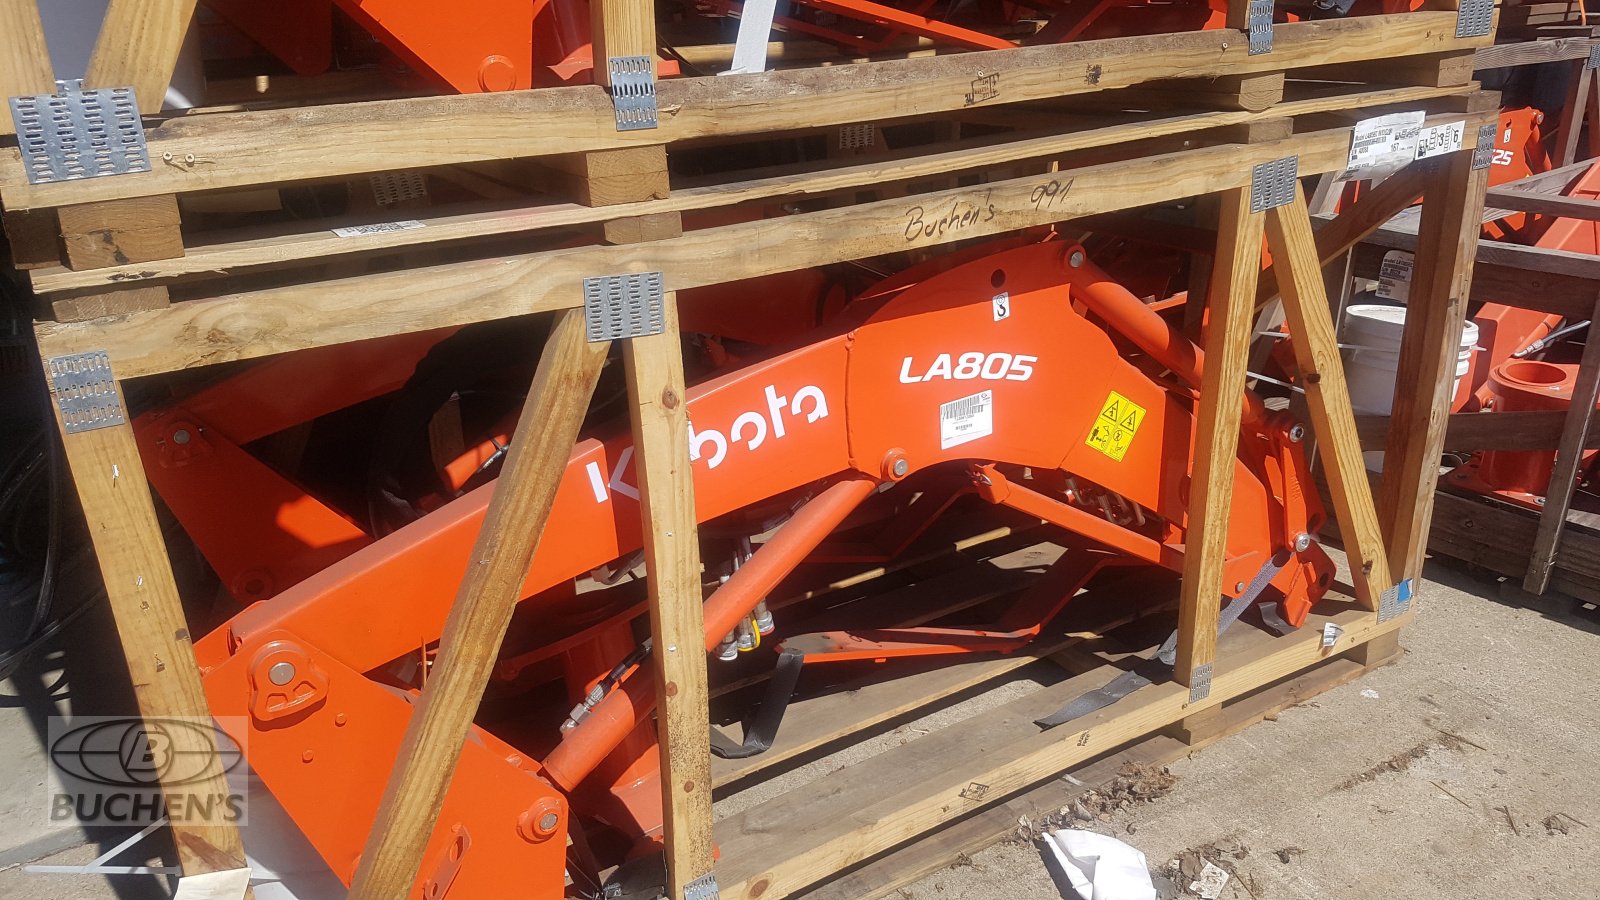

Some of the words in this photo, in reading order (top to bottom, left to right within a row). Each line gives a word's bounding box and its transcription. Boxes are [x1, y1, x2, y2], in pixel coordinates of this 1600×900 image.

[1491, 148, 1514, 166] 25
[904, 187, 995, 242] Buchen's
[1030, 176, 1075, 212] 991
[899, 351, 1038, 384] LA805
[585, 384, 829, 504] Kbota
